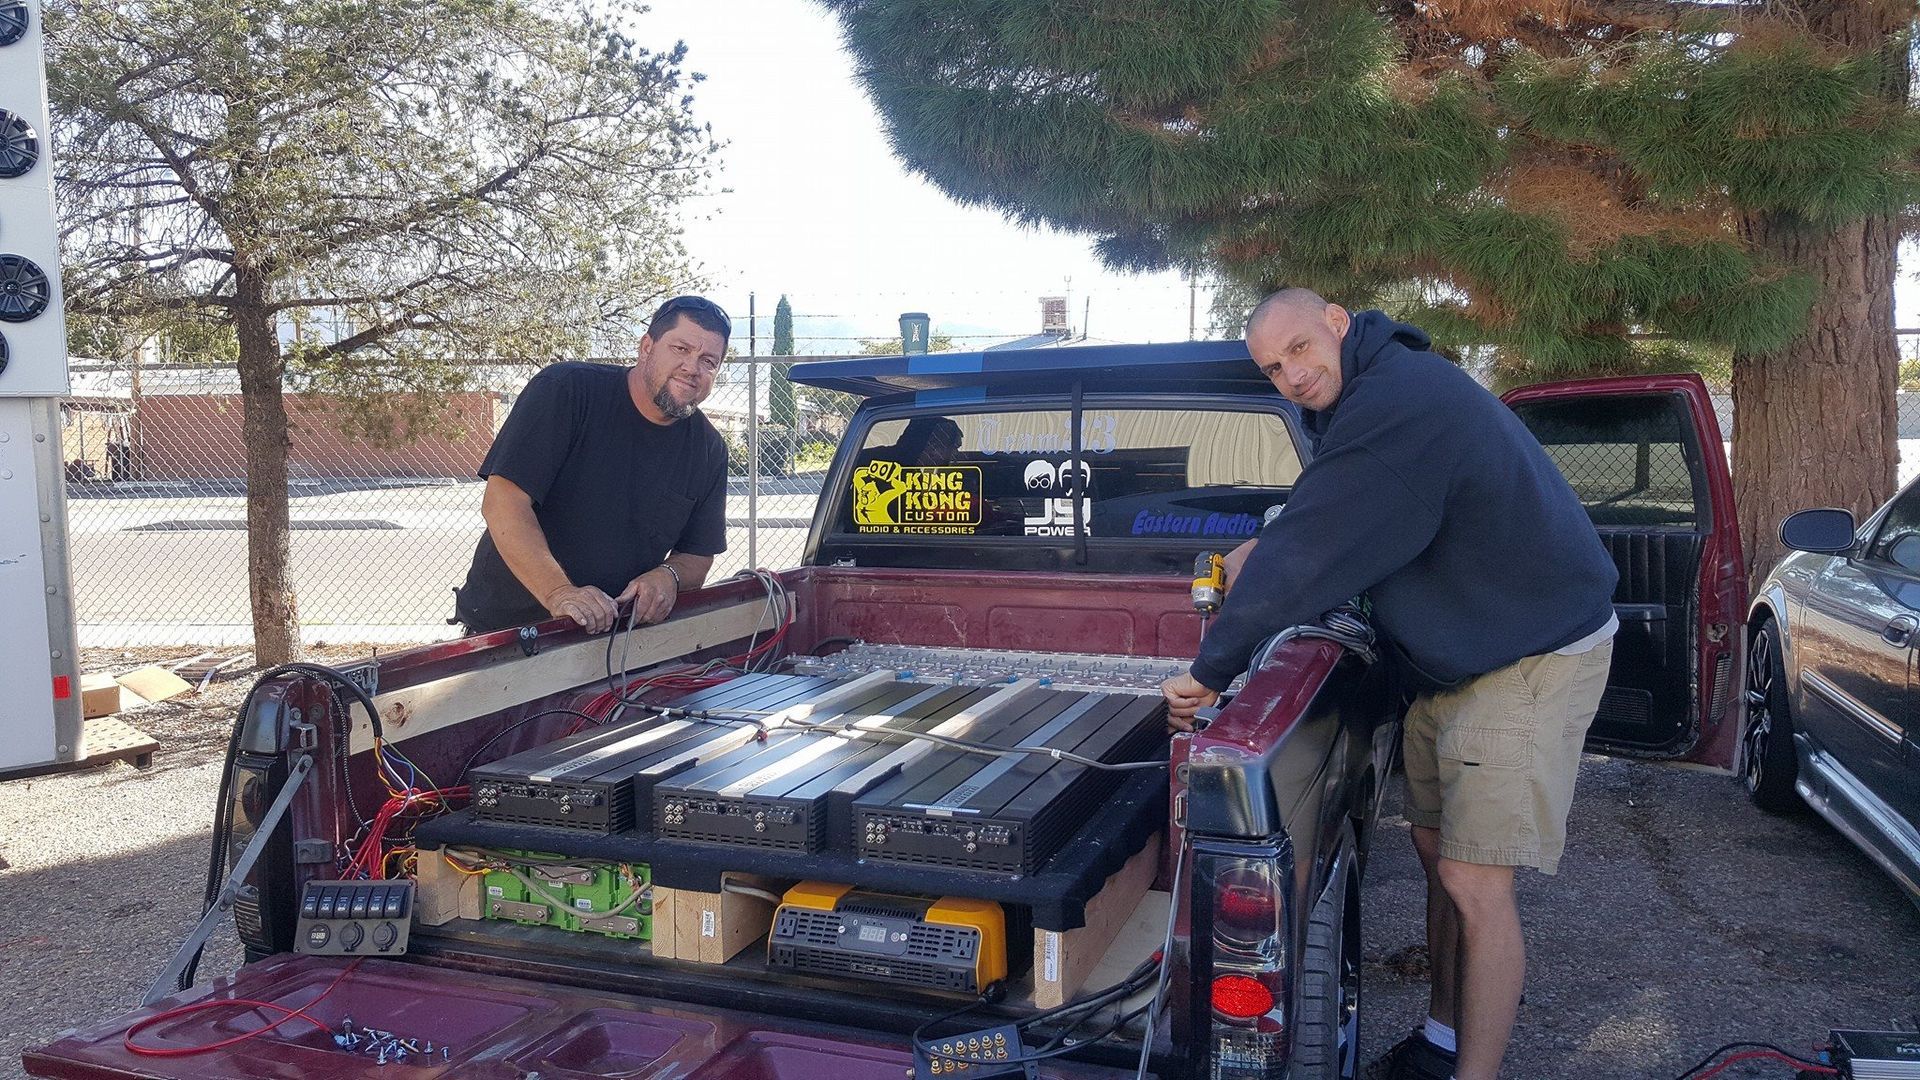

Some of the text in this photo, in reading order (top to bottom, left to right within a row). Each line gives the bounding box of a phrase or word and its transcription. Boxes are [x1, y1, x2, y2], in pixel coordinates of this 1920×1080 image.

[905, 471, 963, 490] KING
[905, 491, 971, 510] KONG
[905, 511, 970, 521] CUSTOM
[1131, 509, 1258, 536] Eastern Audio
[859, 525, 975, 535] AUDIO & ACCESSORIES
